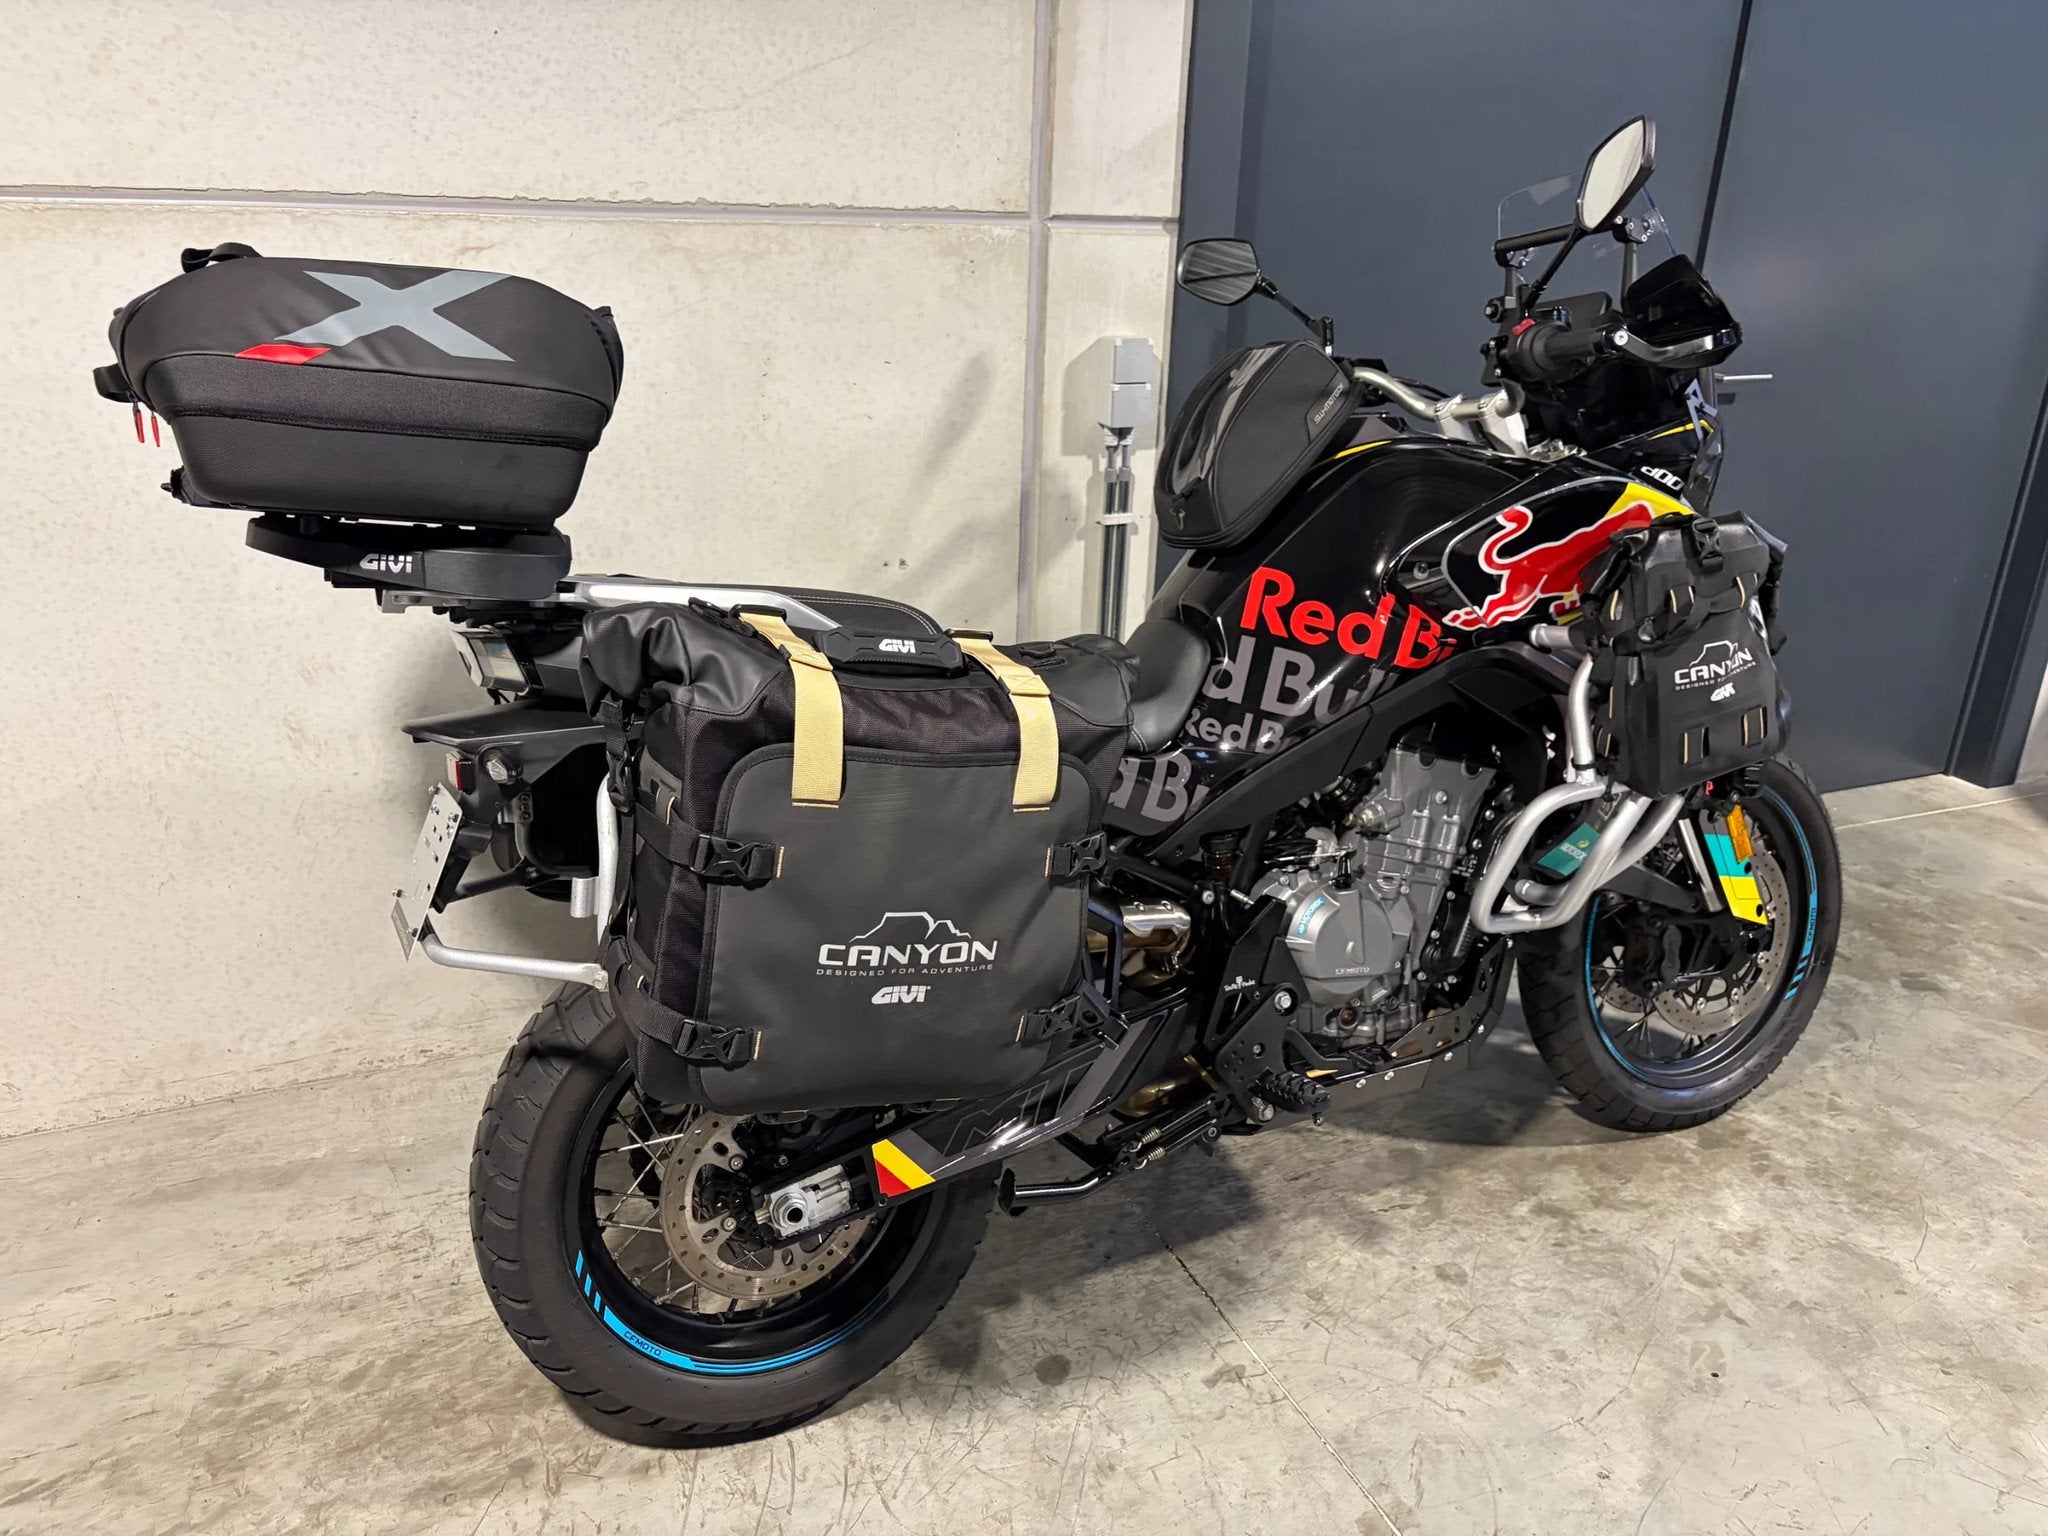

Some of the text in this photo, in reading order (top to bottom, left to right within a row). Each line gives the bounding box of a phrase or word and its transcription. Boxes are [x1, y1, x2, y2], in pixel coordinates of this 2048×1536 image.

[359, 553, 413, 573] GIVI
[1240, 566, 1396, 660] Red
[878, 638, 916, 654] GIVI
[818, 940, 998, 967] CANYON
[816, 963, 994, 977] DESIGNED FOR ADVENTURE
[871, 985, 930, 1005] GIVI
[623, 1330, 662, 1358] CFMOTO
